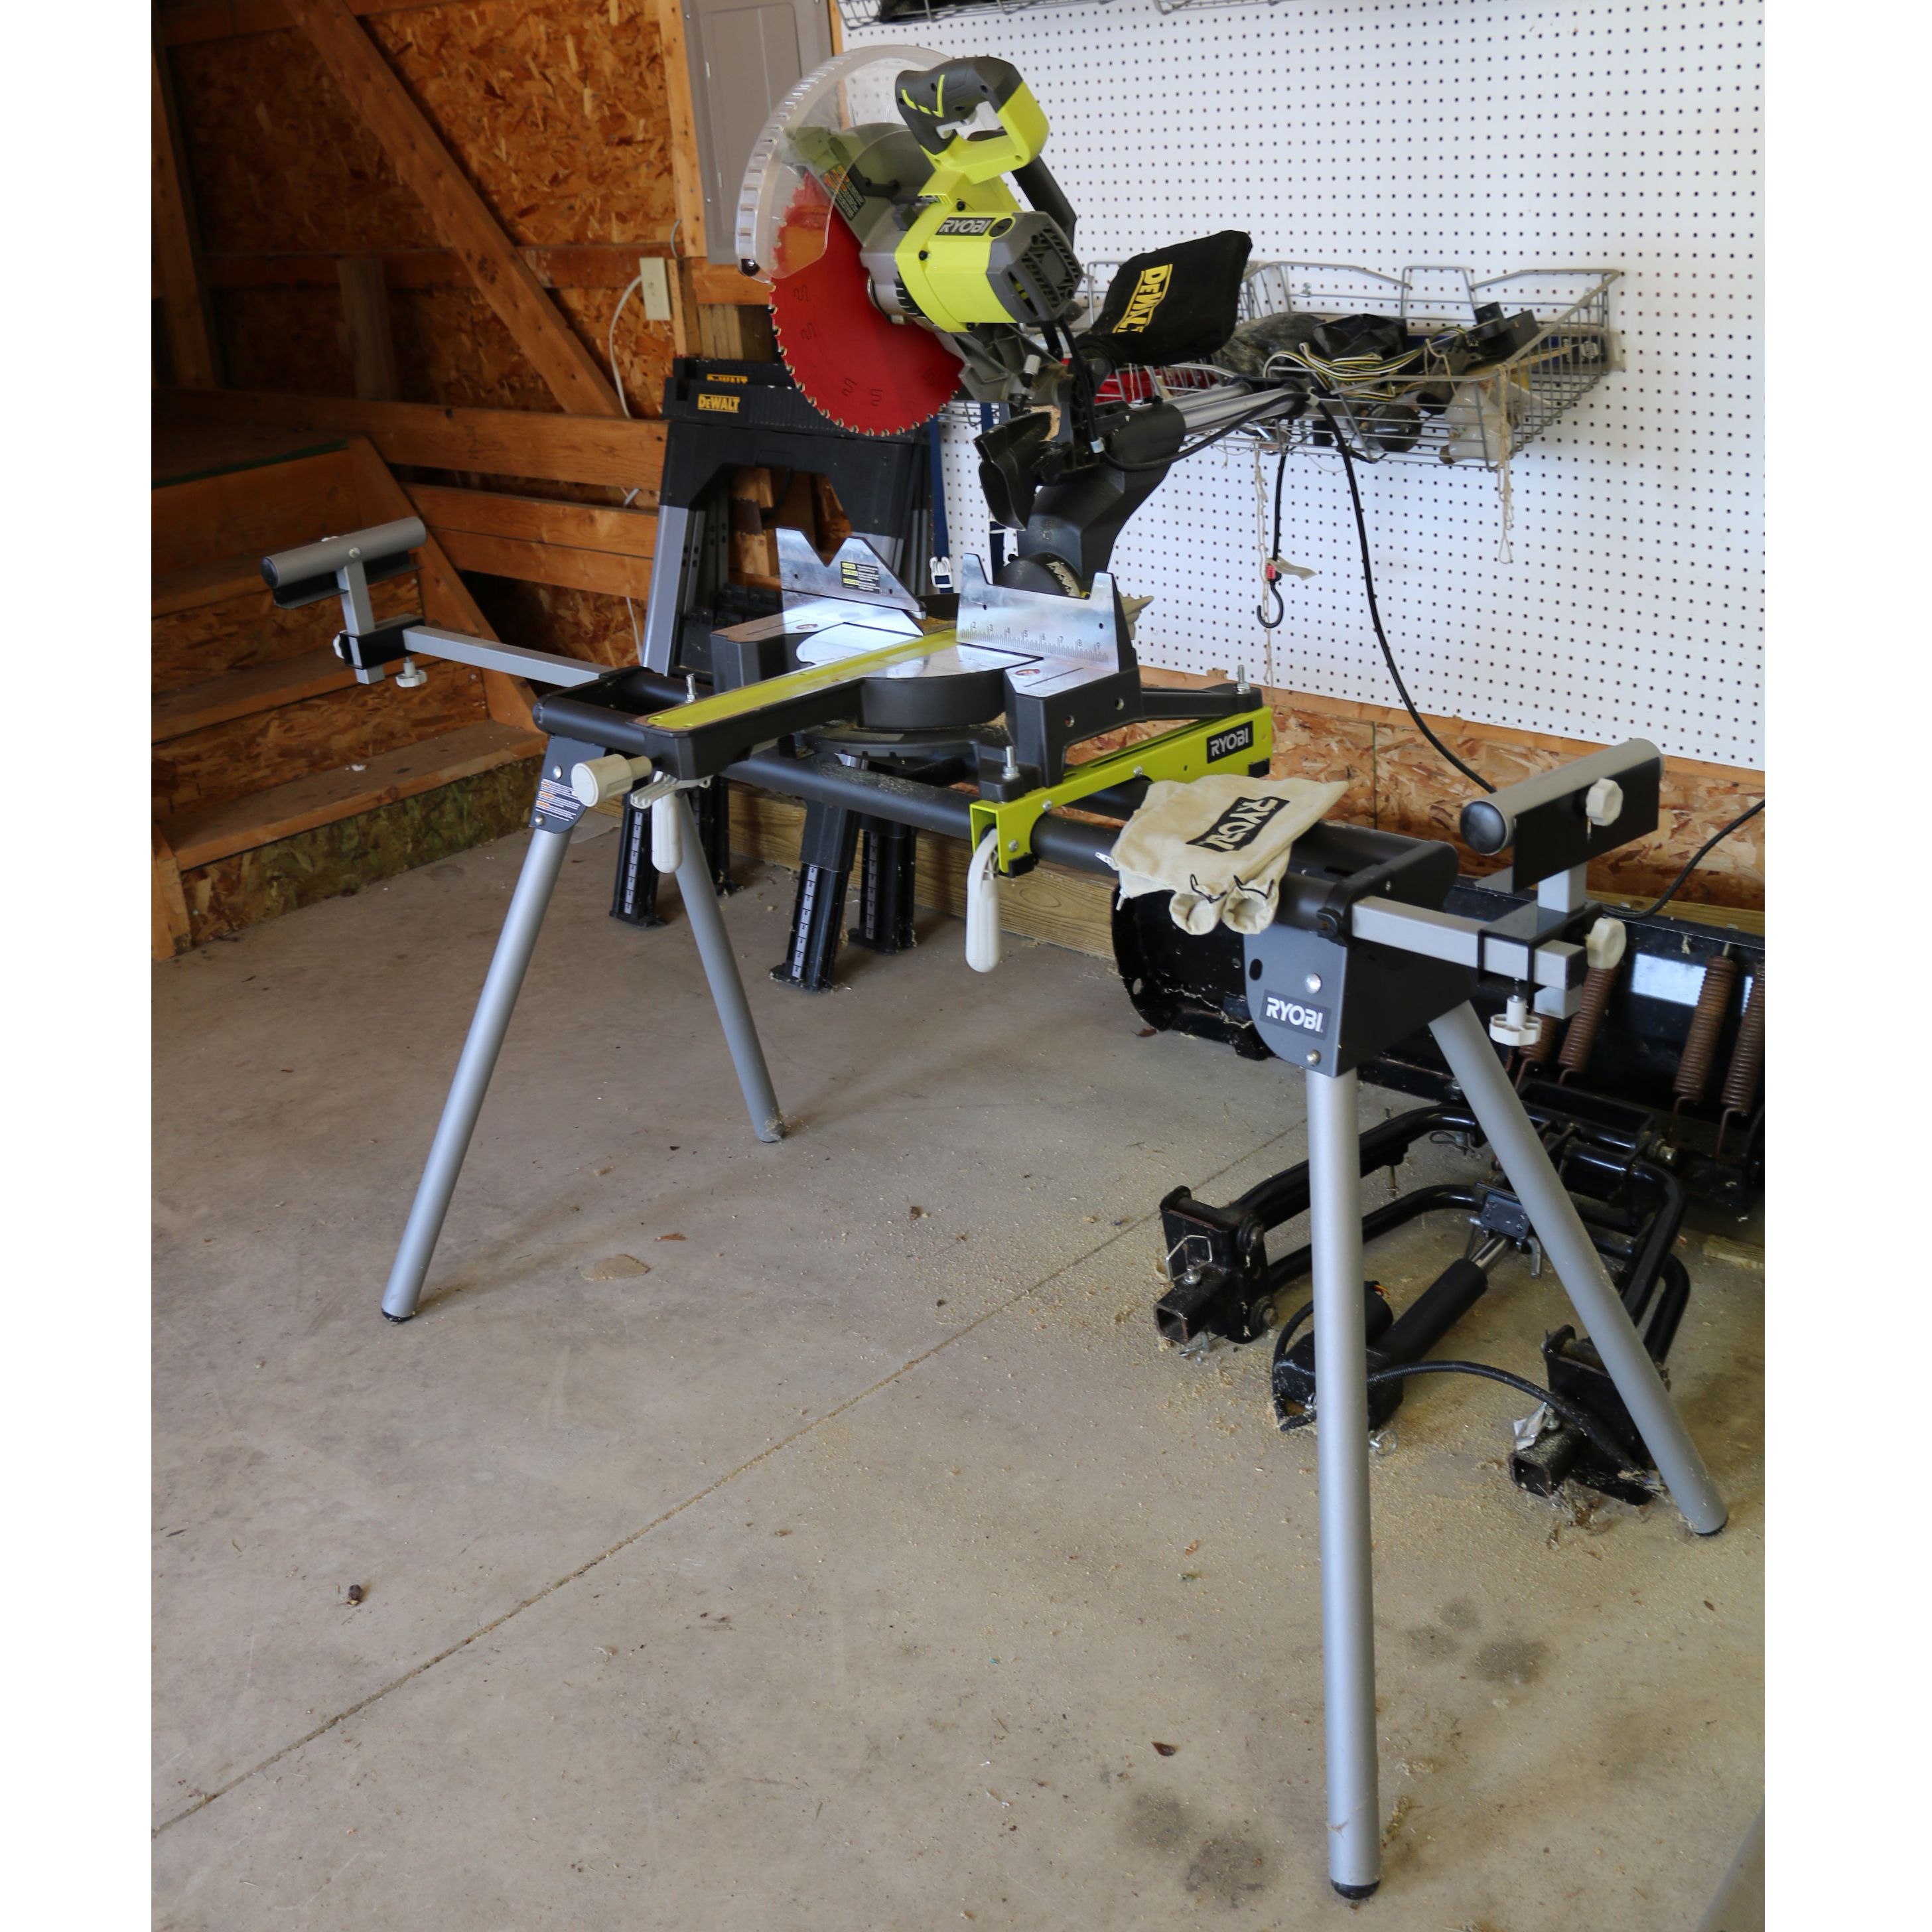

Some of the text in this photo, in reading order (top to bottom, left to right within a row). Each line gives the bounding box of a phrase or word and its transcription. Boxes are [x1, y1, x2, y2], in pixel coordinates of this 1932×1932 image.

[939, 220, 991, 233] RYOBI
[1210, 728, 1249, 756] RYOBI
[1196, 798, 1278, 850] RYOBI
[1266, 997, 1323, 1032] RYOBI
